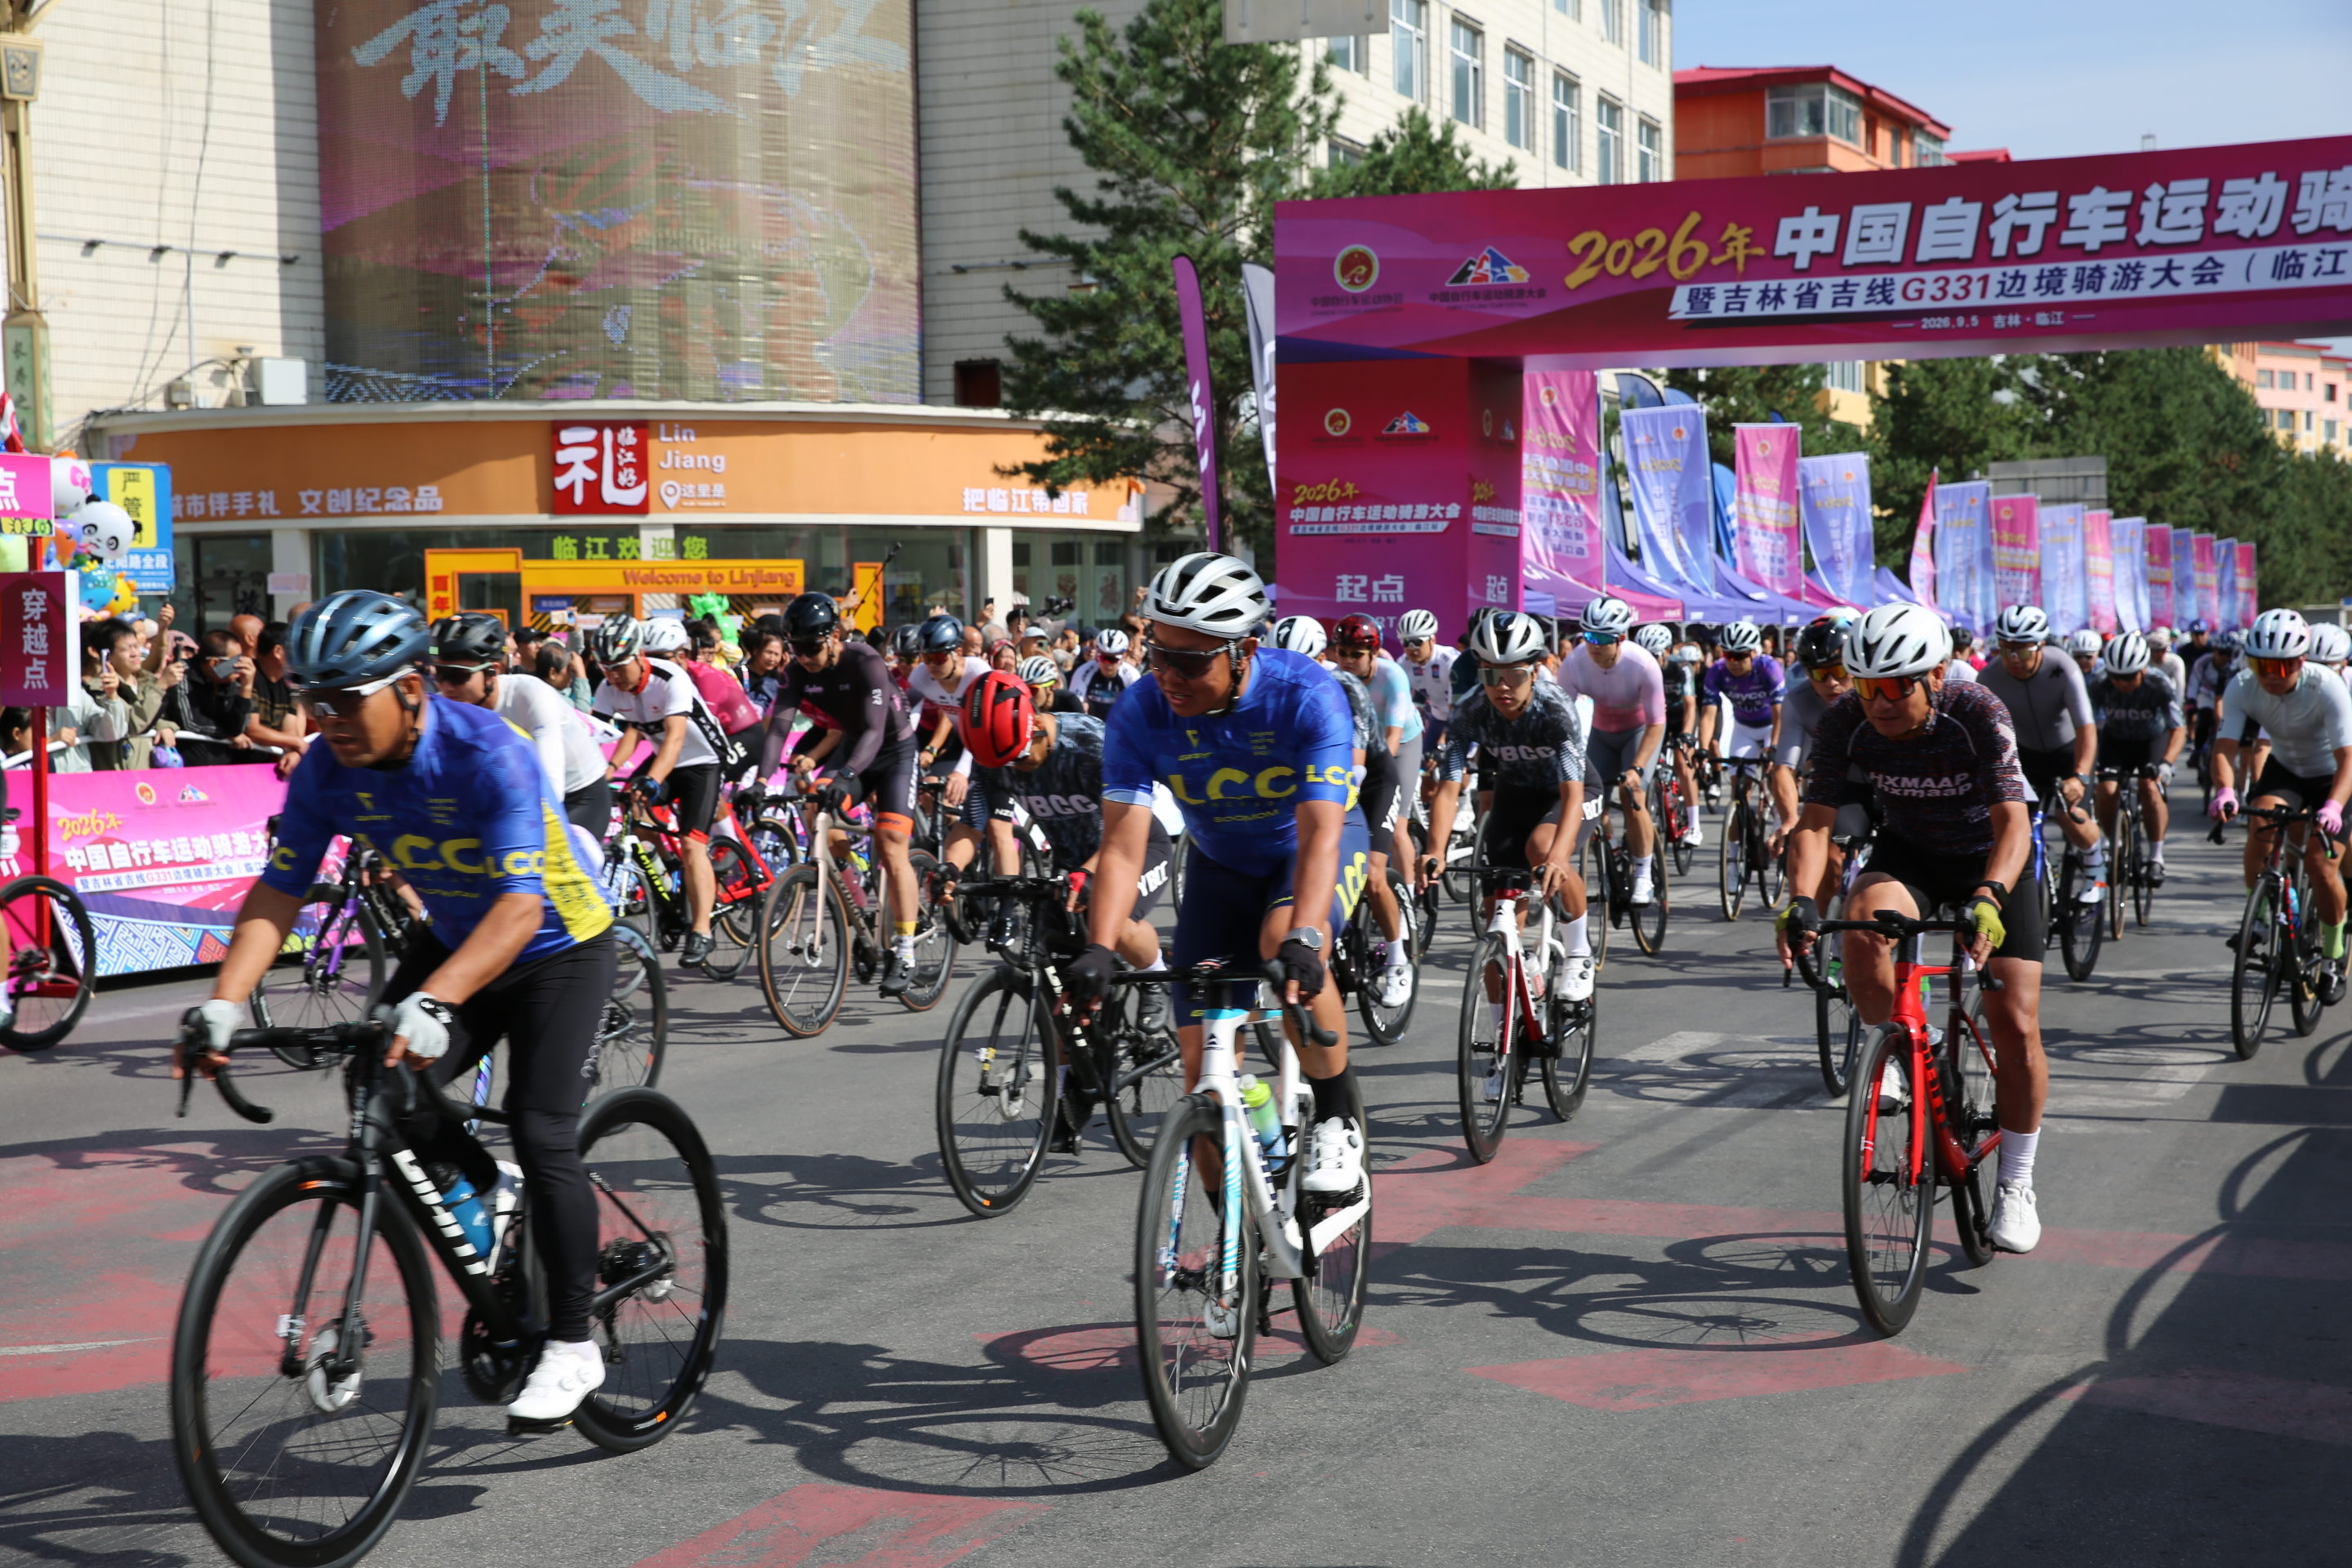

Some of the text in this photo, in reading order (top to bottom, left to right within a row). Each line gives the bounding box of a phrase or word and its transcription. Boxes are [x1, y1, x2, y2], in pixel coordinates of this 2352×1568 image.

[1563, 163, 2352, 291] 2026年 中国自行车运动骑
[659, 423, 696, 443] Lin
[554, 425, 648, 507] 礼
[658, 450, 726, 473] Jiang
[300, 487, 443, 514] 文创纪念品
[681, 483, 726, 500] 这里是
[1293, 478, 1359, 506] 2026年
[1290, 502, 1461, 523] 中国自行车运动骑游大会
[553, 536, 708, 560] 临江欢迎您
[624, 569, 796, 587] Welcome to Linjiang
[1335, 574, 1404, 603] 起点
[1486, 575, 1508, 604] 起点
[21, 588, 49, 690] 穿越点
[871, 688, 884, 706] EVR
[1168, 766, 1298, 805] LCC
[57, 808, 122, 842] 2026年
